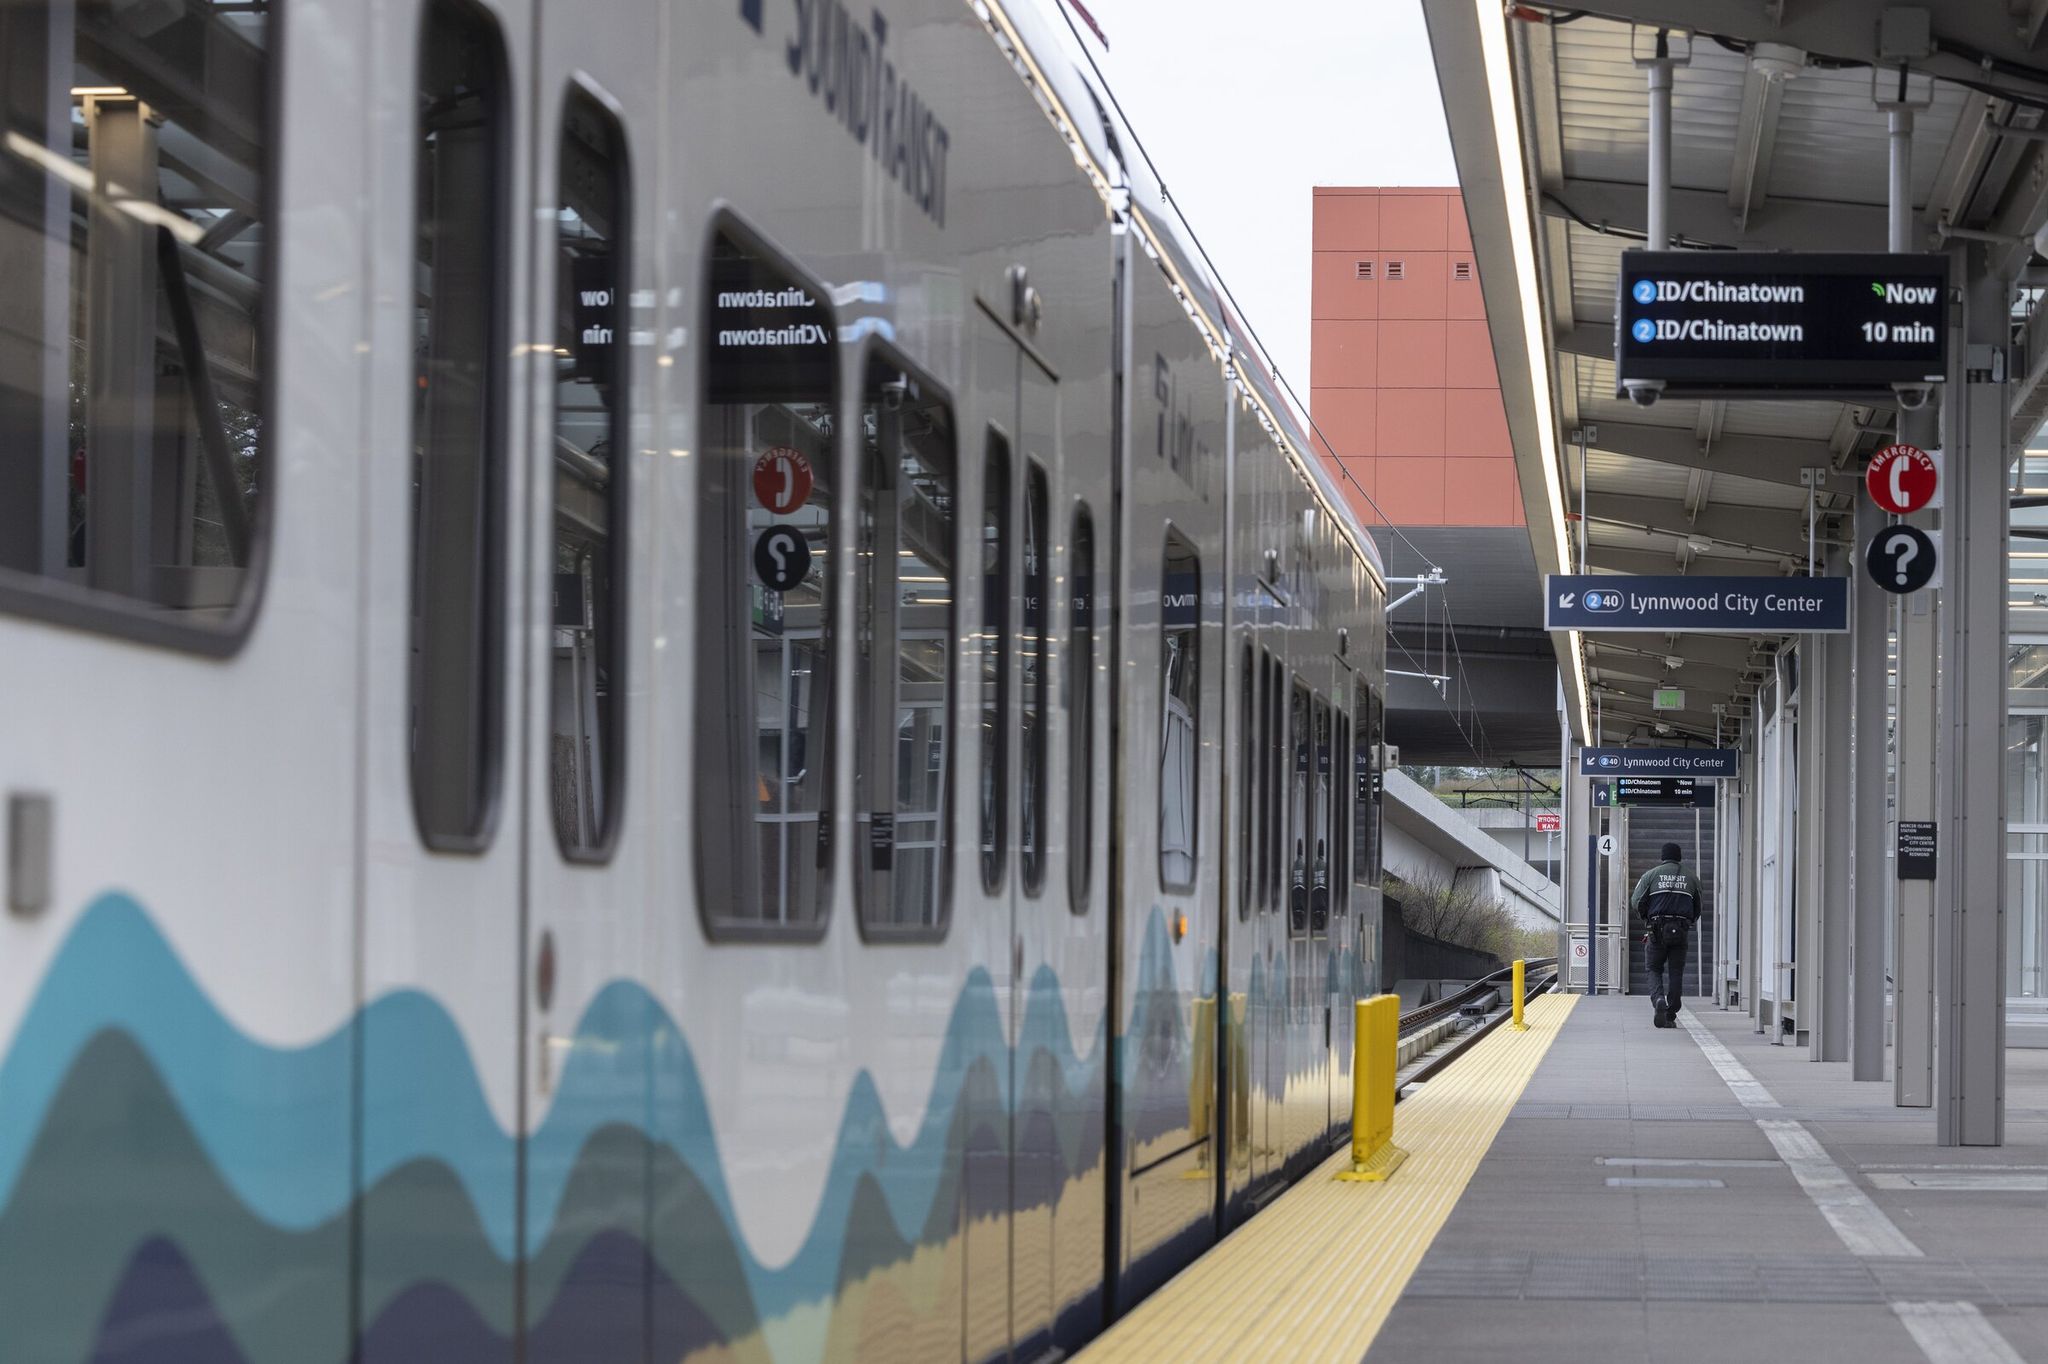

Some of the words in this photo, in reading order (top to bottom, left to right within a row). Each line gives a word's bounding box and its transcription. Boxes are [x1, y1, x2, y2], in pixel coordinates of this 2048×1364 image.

[1656, 281, 1804, 302] ID/Chinatown
[1886, 283, 1936, 304] Now
[1656, 319, 1803, 341] ID/Chinatown
[1862, 322, 1887, 342] 10
[1892, 322, 1935, 342] min
[1870, 445, 1934, 472] EMERGENCY
[1602, 595, 1619, 607] 40
[1630, 593, 1718, 614] Lynnwood
[1725, 594, 1758, 615] City
[1764, 594, 1823, 611] Center
[1624, 757, 1670, 768] Lynnwood
[1673, 757, 1690, 769] City
[1693, 757, 1724, 767] Center
[1602, 838, 1611, 852] 4
